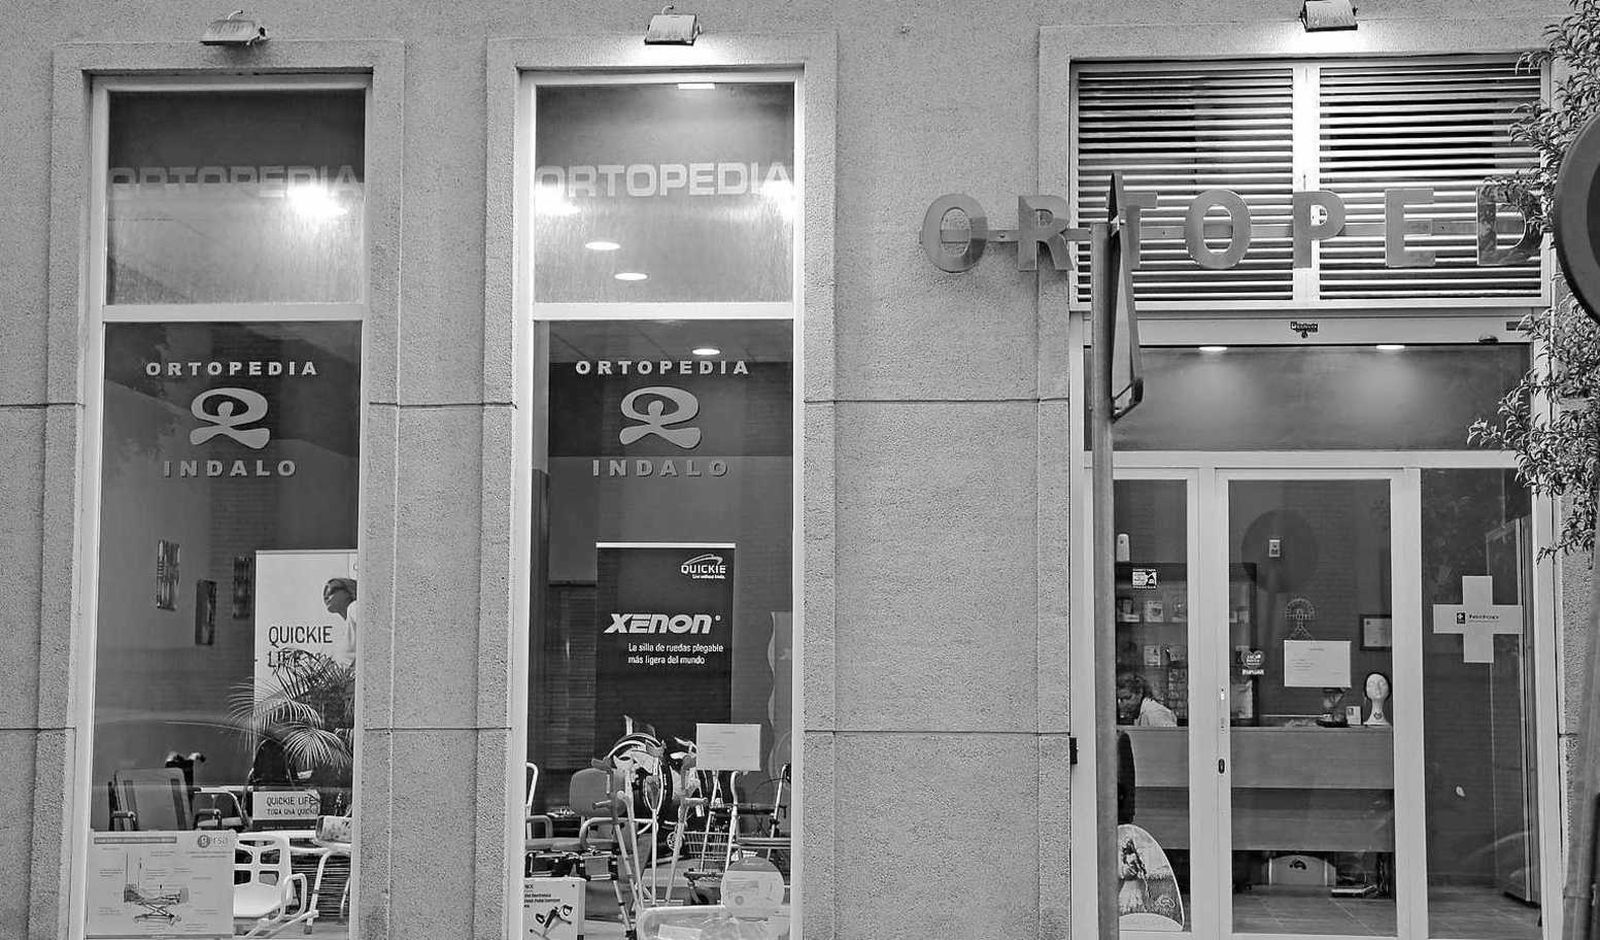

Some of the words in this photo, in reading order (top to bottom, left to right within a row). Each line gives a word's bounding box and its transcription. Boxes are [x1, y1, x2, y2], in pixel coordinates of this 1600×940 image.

[535, 162, 792, 198] ORTOPEDIA
[145, 361, 318, 377] ORTOPEDIA
[575, 360, 750, 376] ORTOPEDIA
[163, 459, 297, 478] INDALO
[592, 459, 729, 478] INDALO
[680, 564, 727, 575] QUICKIE
[267, 625, 334, 649] QUICKIE
[638, 642, 654, 653] silla
[655, 642, 666, 653] de
[666, 643, 692, 653] ruedas
[692, 643, 724, 655] plegable
[627, 654, 644, 664] más
[645, 654, 666, 666] ligera
[667, 655, 679, 664] del
[680, 655, 706, 665] mundo
[266, 796, 296, 808] QUICKIE
